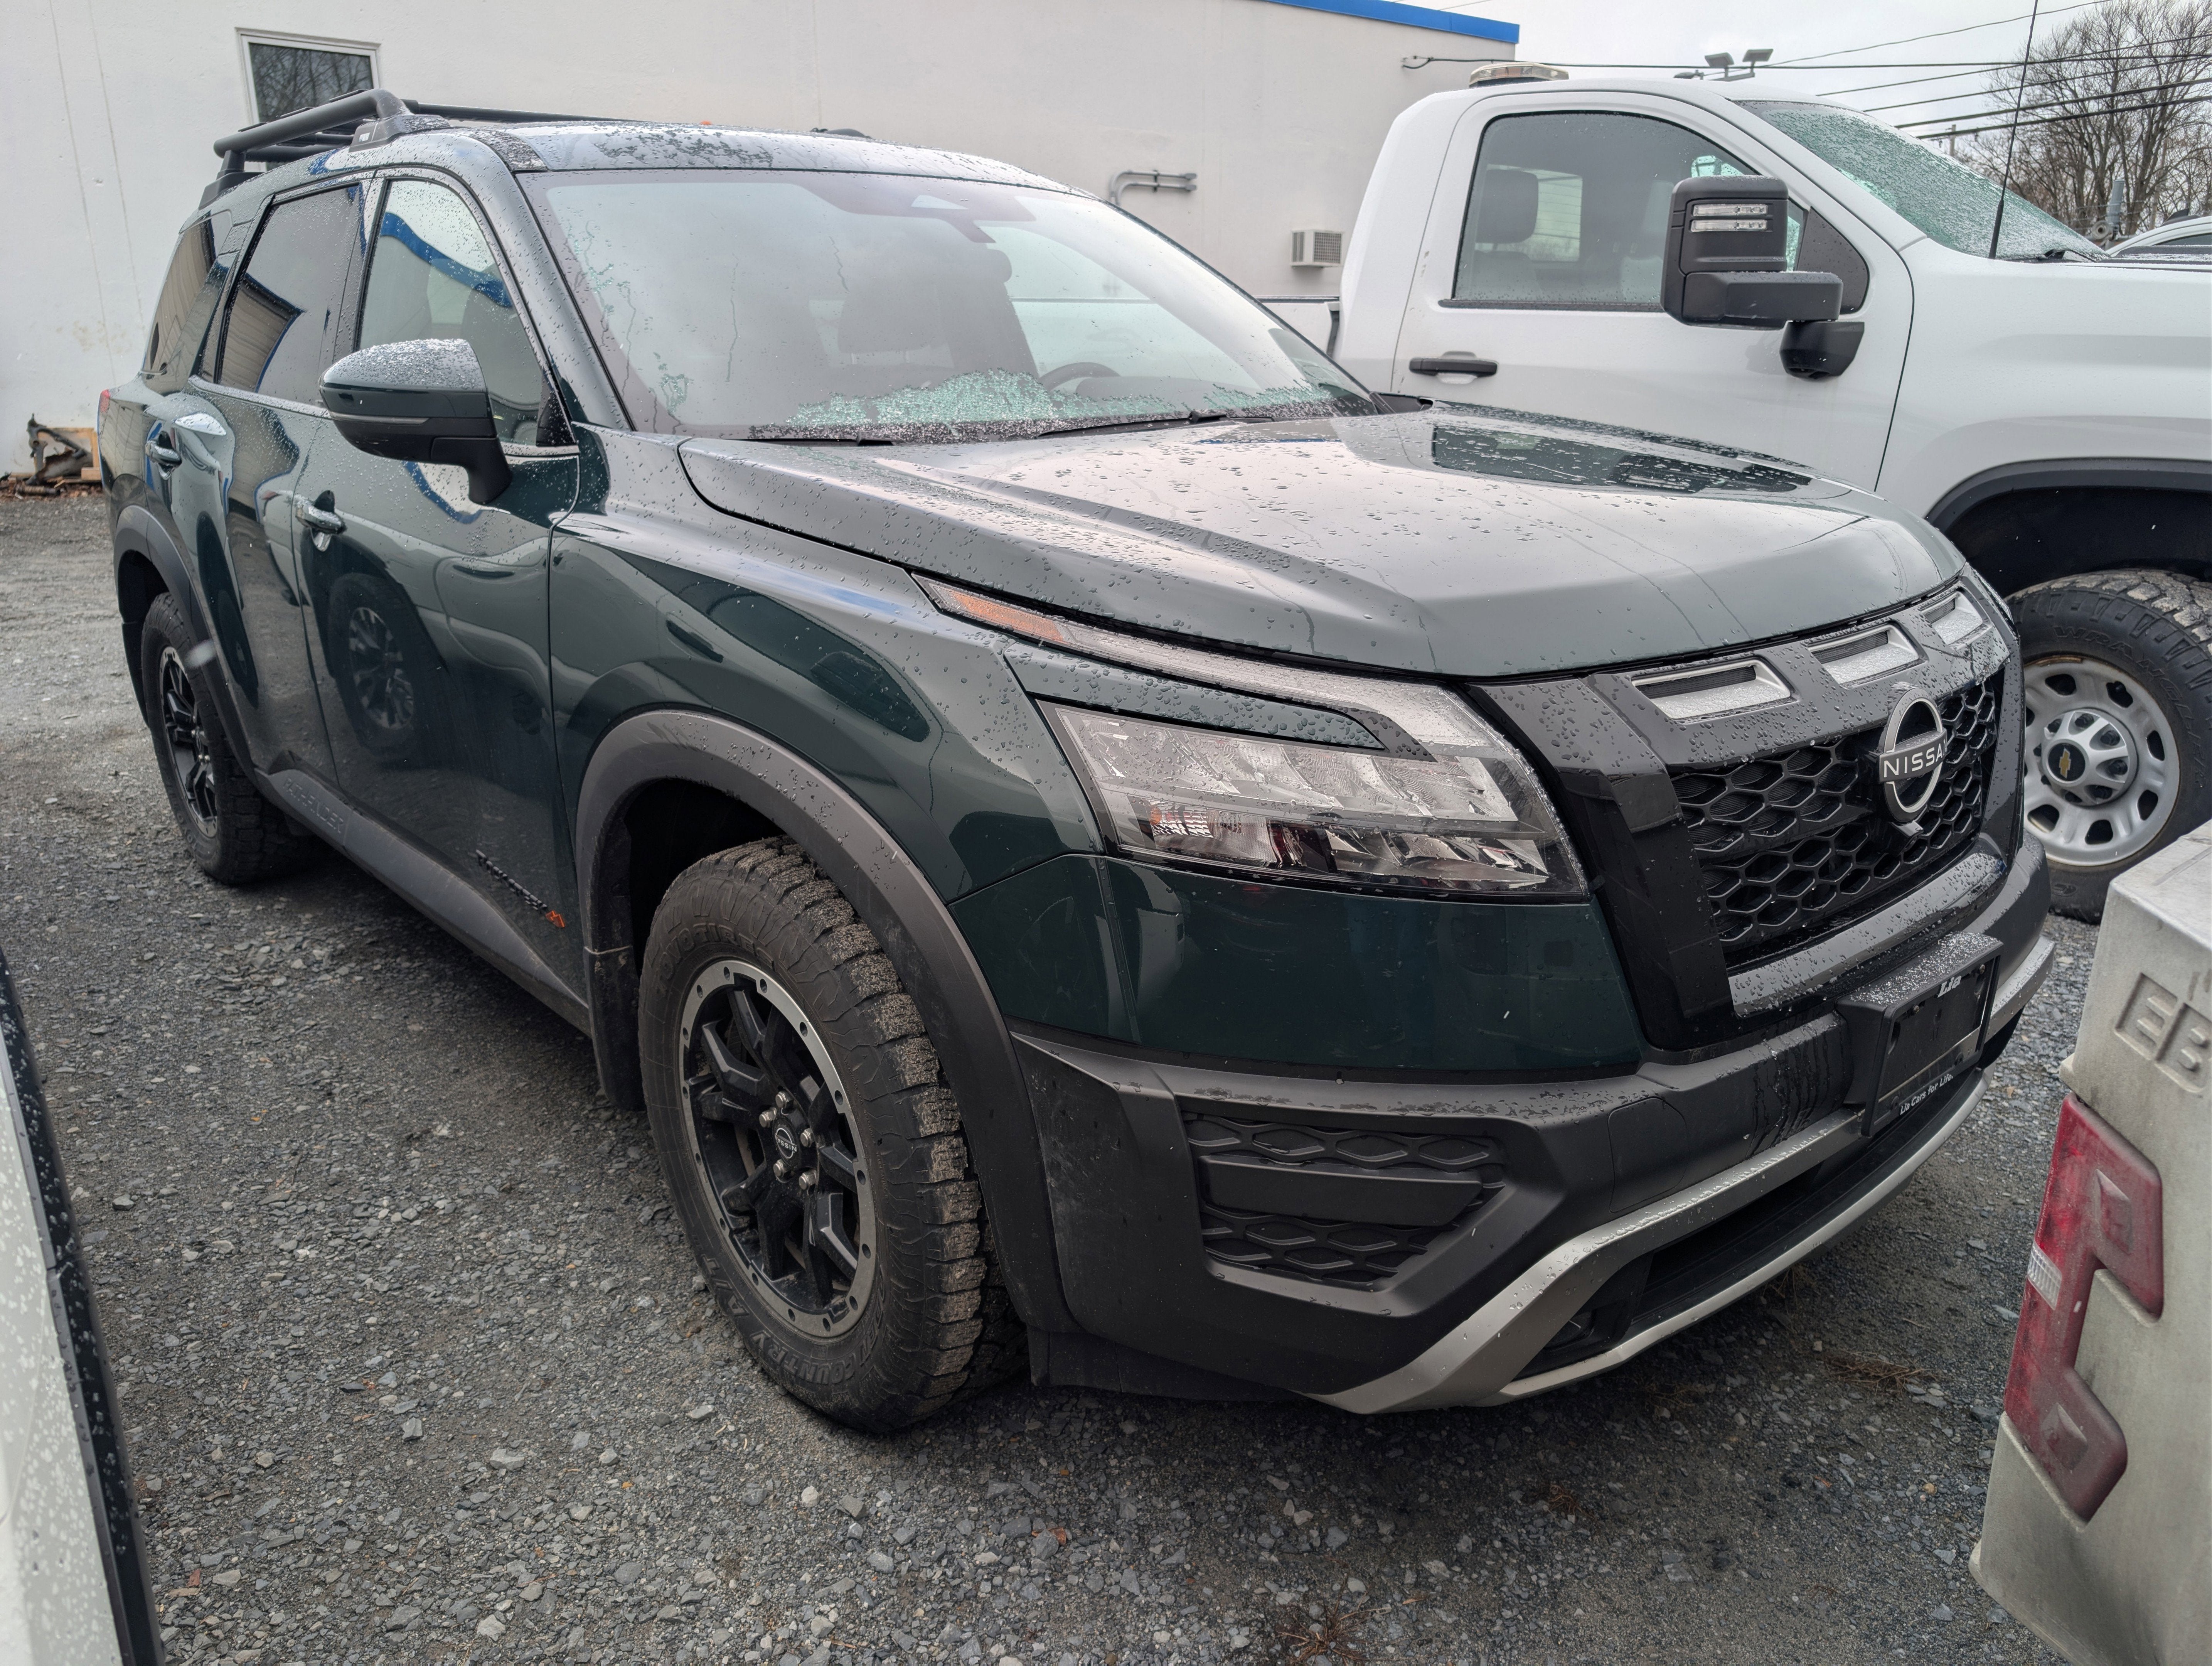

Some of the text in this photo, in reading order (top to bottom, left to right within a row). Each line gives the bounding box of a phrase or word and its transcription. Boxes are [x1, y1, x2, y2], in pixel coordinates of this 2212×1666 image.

[1883, 739, 1947, 774] NISSAN
[1937, 975, 1962, 998] Lia
[1900, 1073, 1954, 1116] Lia Cars for Life.
[700, 1254, 750, 1317] A/T
[750, 1330, 856, 1384] COUNTRY
